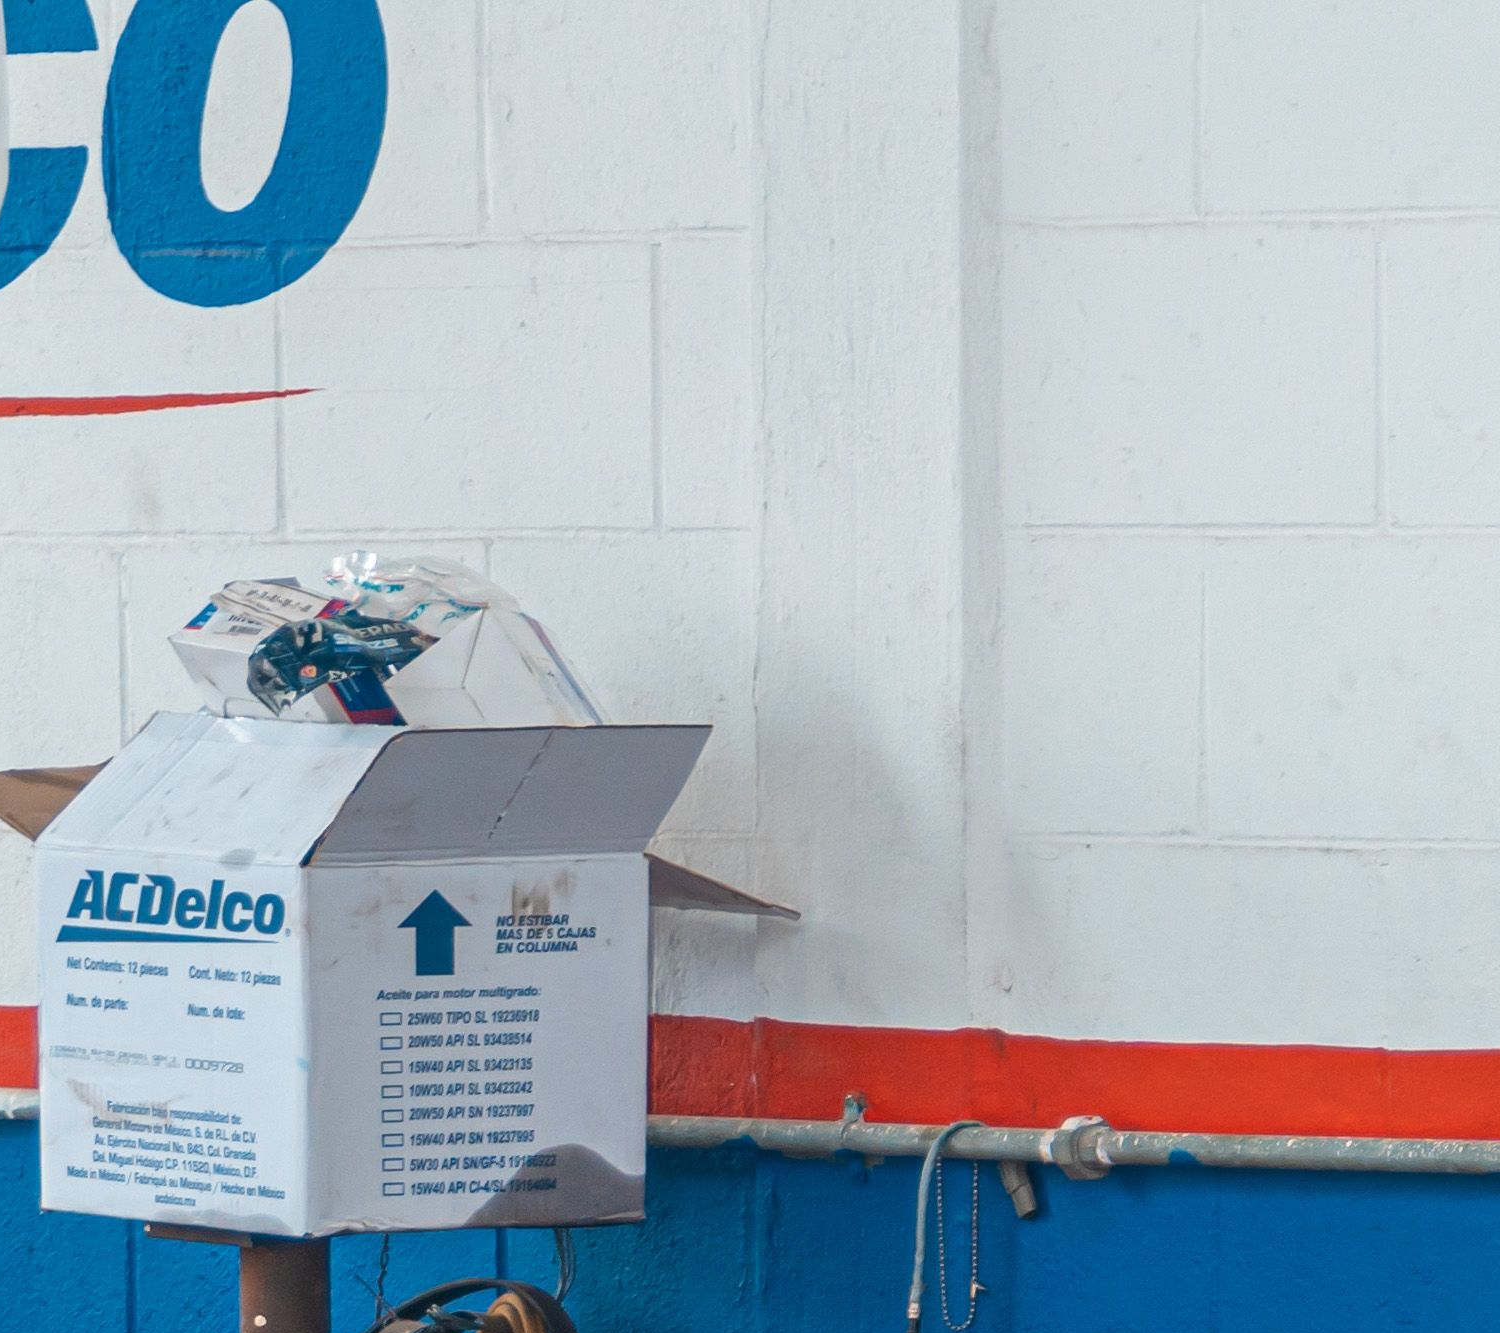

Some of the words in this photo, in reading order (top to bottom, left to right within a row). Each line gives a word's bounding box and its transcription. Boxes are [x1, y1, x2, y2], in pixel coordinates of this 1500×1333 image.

[66, 869, 285, 934] ACDelco
[496, 915, 516, 927] NO
[518, 914, 569, 926] ESTIBAR
[496, 929, 524, 940] MAS
[526, 928, 543, 939] DE
[556, 927, 596, 938] CAJAS
[496, 942, 513, 954] EN
[516, 941, 578, 953] COLUMNA
[67, 956, 81, 969] Net
[128, 961, 138, 974] 12
[139, 962, 169, 977] pieces
[241, 970, 251, 983] 12
[252, 972, 281, 986] piezas
[377, 989, 412, 1001] Aceite
[414, 989, 439, 1002] para
[442, 988, 475, 999] motor
[478, 986, 542, 1000] multigrado:
[91, 995, 101, 1008] de
[212, 1005, 224, 1018] de
[445, 1011, 472, 1024] TIPO
[474, 1011, 488, 1024] SL
[408, 1034, 444, 1048] 20W50
[445, 1034, 465, 1047] API
[467, 1033, 481, 1047] SL
[409, 1060, 444, 1073] 15W40
[445, 1060, 465, 1073] API
[467, 1059, 481, 1072] SL
[409, 1084, 444, 1097] 10W30
[446, 1083, 465, 1096] API
[468, 1082, 482, 1095] SL
[409, 1107, 444, 1120] 20W50
[446, 1106, 466, 1119] API
[468, 1105, 484, 1118] SN
[410, 1133, 445, 1146] 15W40
[447, 1132, 466, 1145] API
[468, 1131, 484, 1144] SN
[410, 1157, 439, 1171] 5W30
[441, 1157, 460, 1170] API
[411, 1182, 445, 1195] 15W40
[447, 1181, 466, 1194] API
